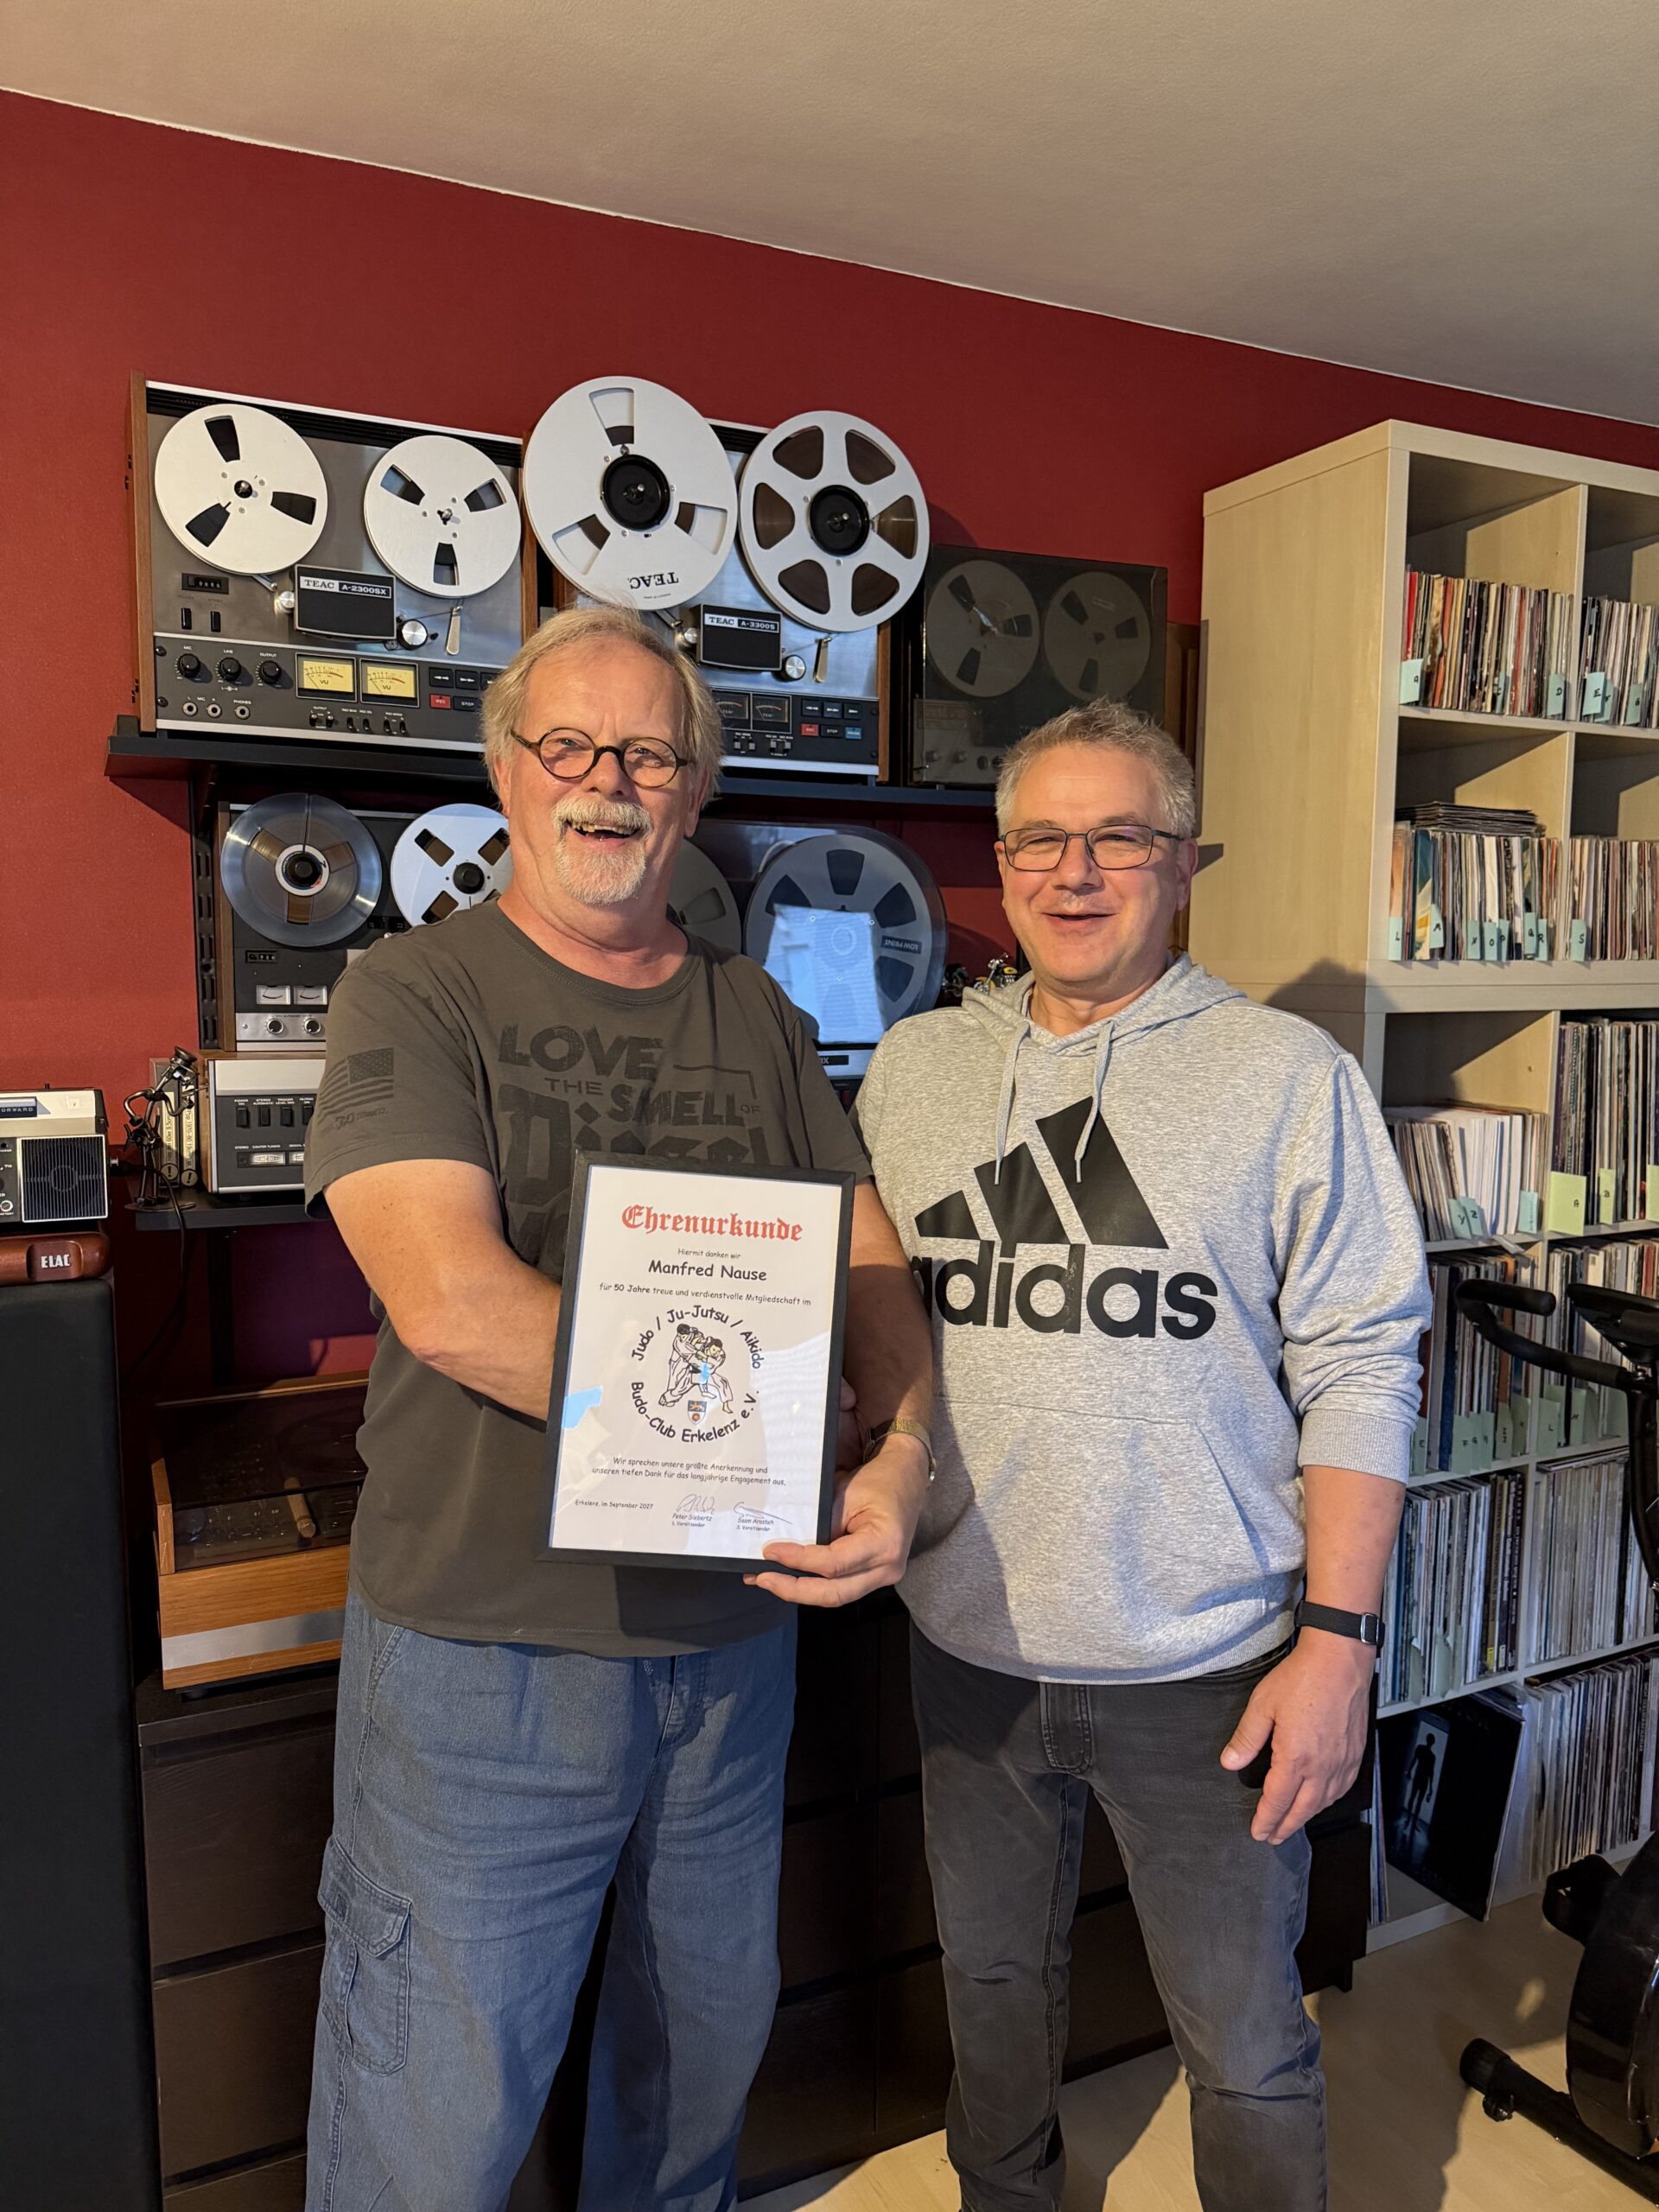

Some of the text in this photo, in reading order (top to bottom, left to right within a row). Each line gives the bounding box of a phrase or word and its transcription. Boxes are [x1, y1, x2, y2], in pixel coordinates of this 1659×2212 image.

[304, 579, 387, 594] TEAC A-2300SX
[628, 572, 679, 589] TEAC
[709, 616, 775, 630] TEAC A-3300S
[499, 1023, 665, 1080] LOVE
[544, 1077, 761, 1127] THE SMELL OF
[622, 1204, 803, 1242] Ehrenurkunde
[41, 1254, 70, 1268] ELAC
[677, 1249, 703, 1257] Hiermit
[705, 1250, 729, 1259] danken
[648, 1259, 767, 1281] Manfred Nause
[600, 1282, 613, 1291] für
[613, 1283, 625, 1292] 50
[626, 1284, 651, 1294] Jahre
[690, 1290, 743, 1300] verdienstvolle
[745, 1294, 800, 1305] Mitgliedschaft
[632, 1329, 654, 1361] Judo
[666, 1305, 729, 1324] Ju-Jutsu
[740, 1331, 764, 1370] Aikido
[632, 1382, 676, 1439] Budo-Club
[681, 1419, 741, 1443] Erkelenz
[592, 1467, 620, 1476] unseren
[621, 1468, 643, 1477] tiefen
[730, 1474, 771, 1486] Engagement
[627, 1459, 660, 1467] sprechen
[710, 1463, 754, 1475] Anerkennung
